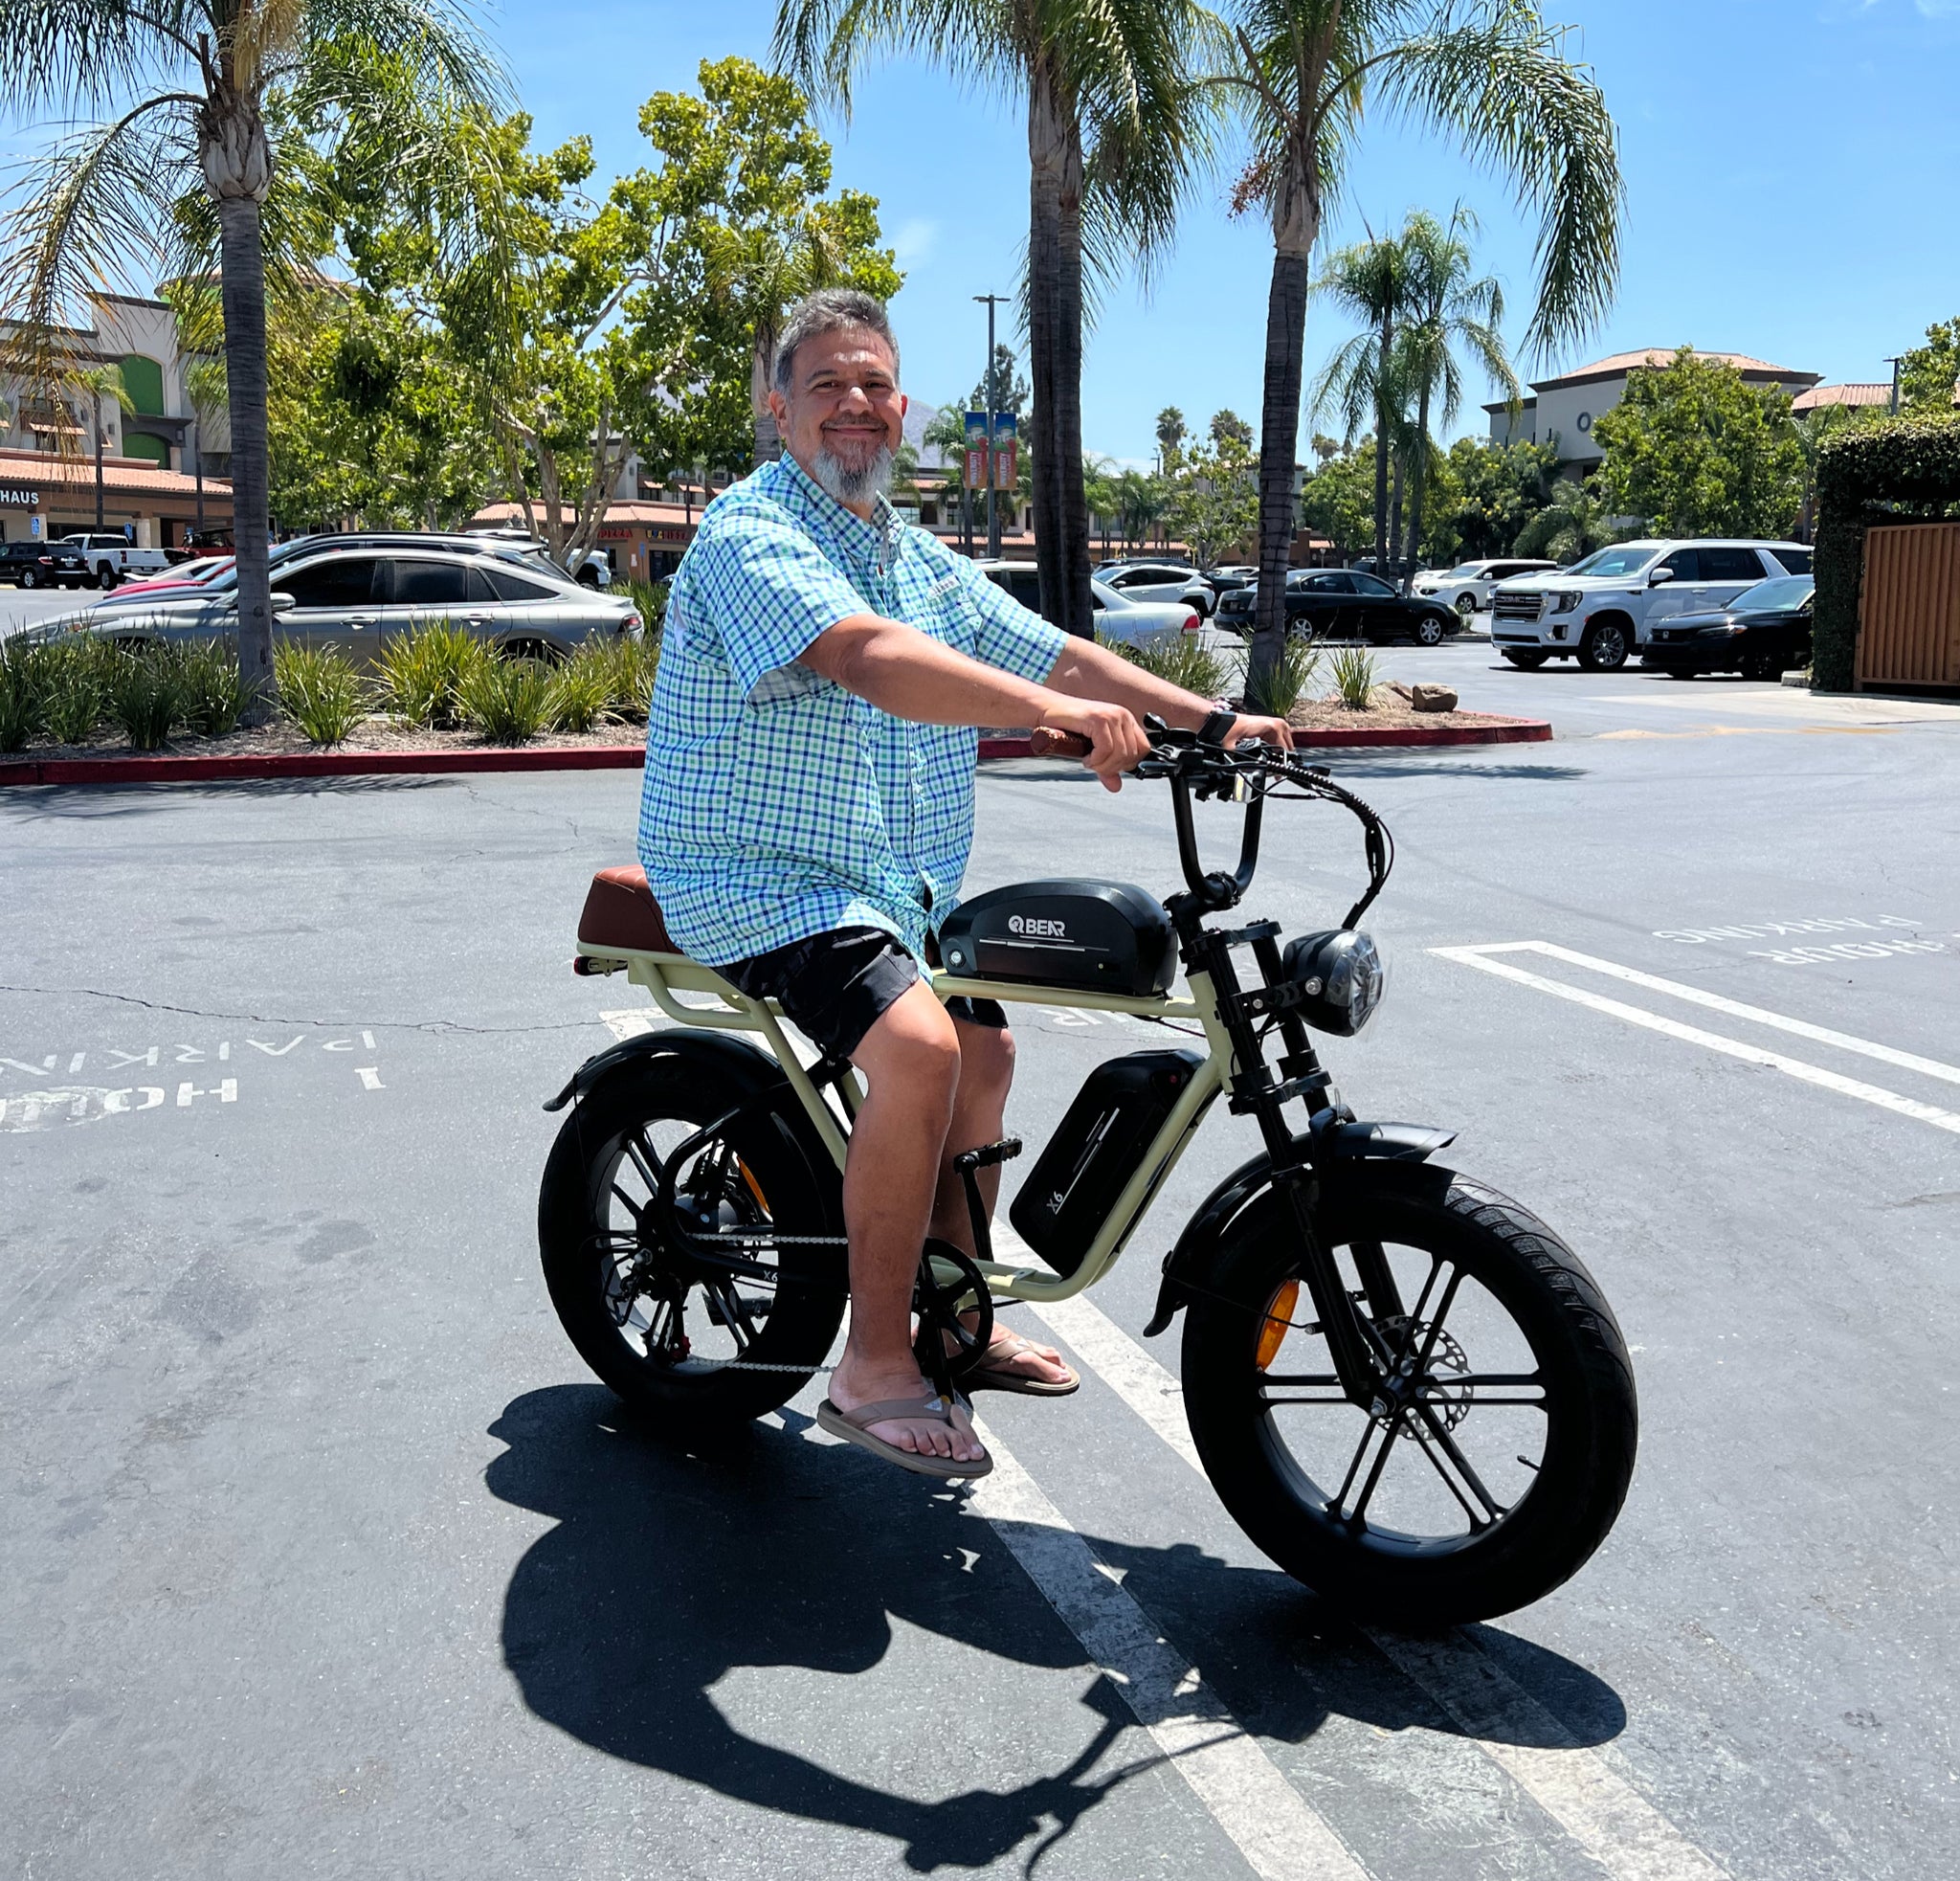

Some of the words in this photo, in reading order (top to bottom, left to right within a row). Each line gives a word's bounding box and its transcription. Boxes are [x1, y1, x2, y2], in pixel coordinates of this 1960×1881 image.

[0, 490, 39, 504] HAUS
[1652, 913, 1923, 944] PARKING
[353, 1065, 387, 1090] 1
[1046, 1190, 1063, 1213] X6
[763, 1269, 779, 1283] X6
